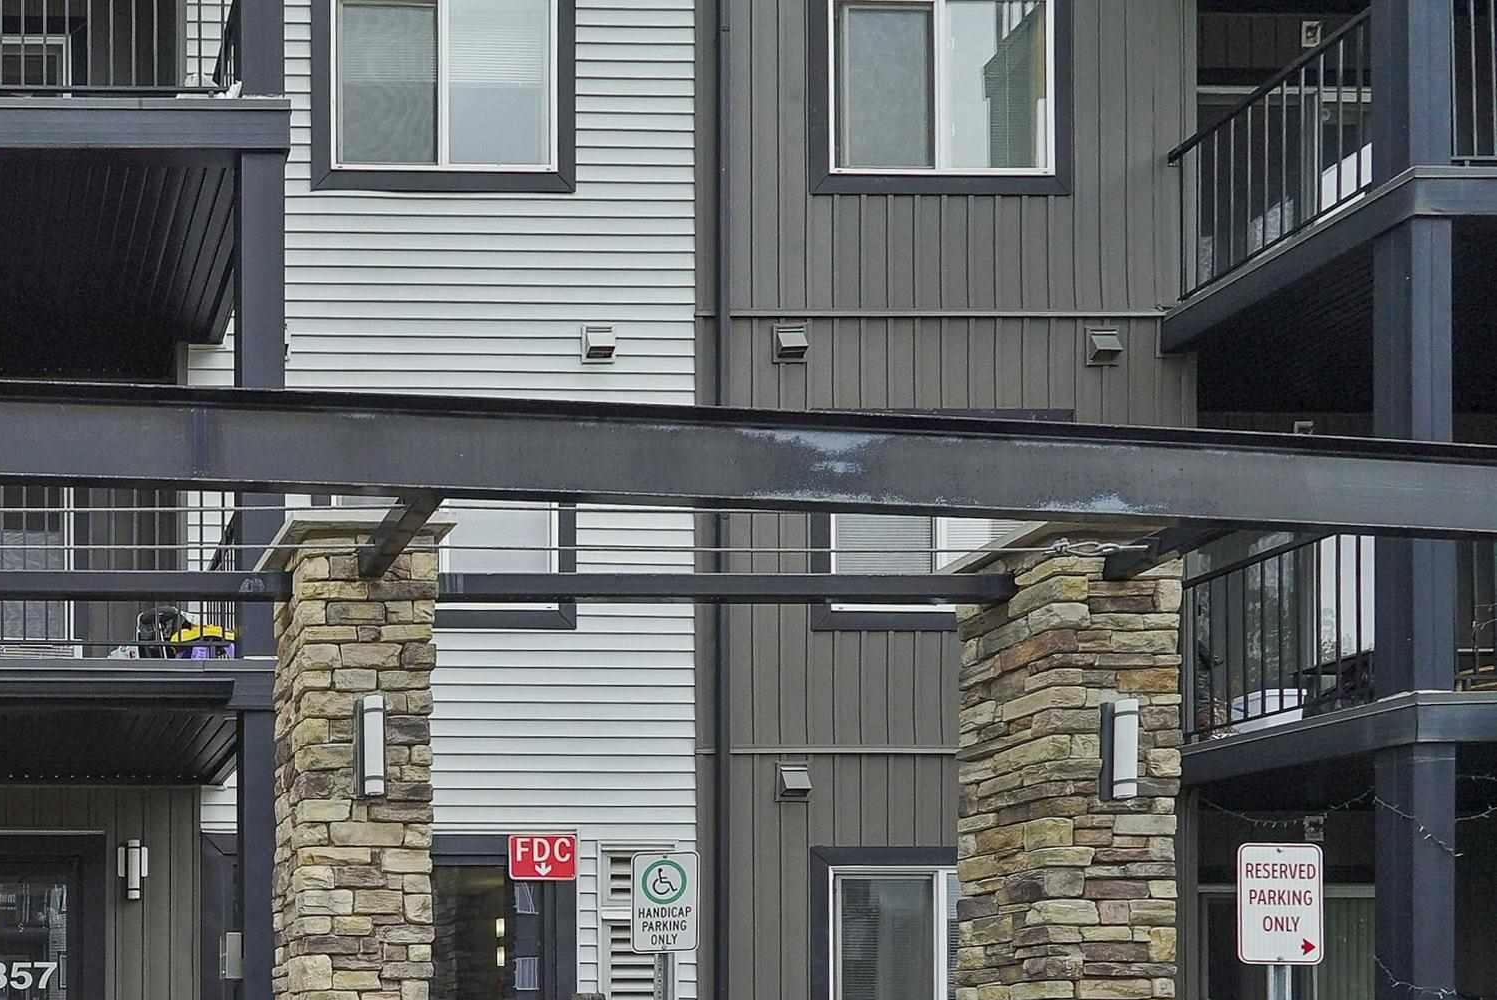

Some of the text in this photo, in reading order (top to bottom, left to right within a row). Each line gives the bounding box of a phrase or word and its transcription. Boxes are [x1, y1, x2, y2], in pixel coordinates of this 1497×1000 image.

[515, 837, 571, 862] FDC
[1245, 863, 1317, 880] RESERVED
[1249, 889, 1313, 906] PARKING
[638, 906, 692, 919] HANDICAP
[641, 920, 688, 932] PARKING
[1262, 915, 1300, 932] ONLY
[650, 934, 678, 946] ONLY
